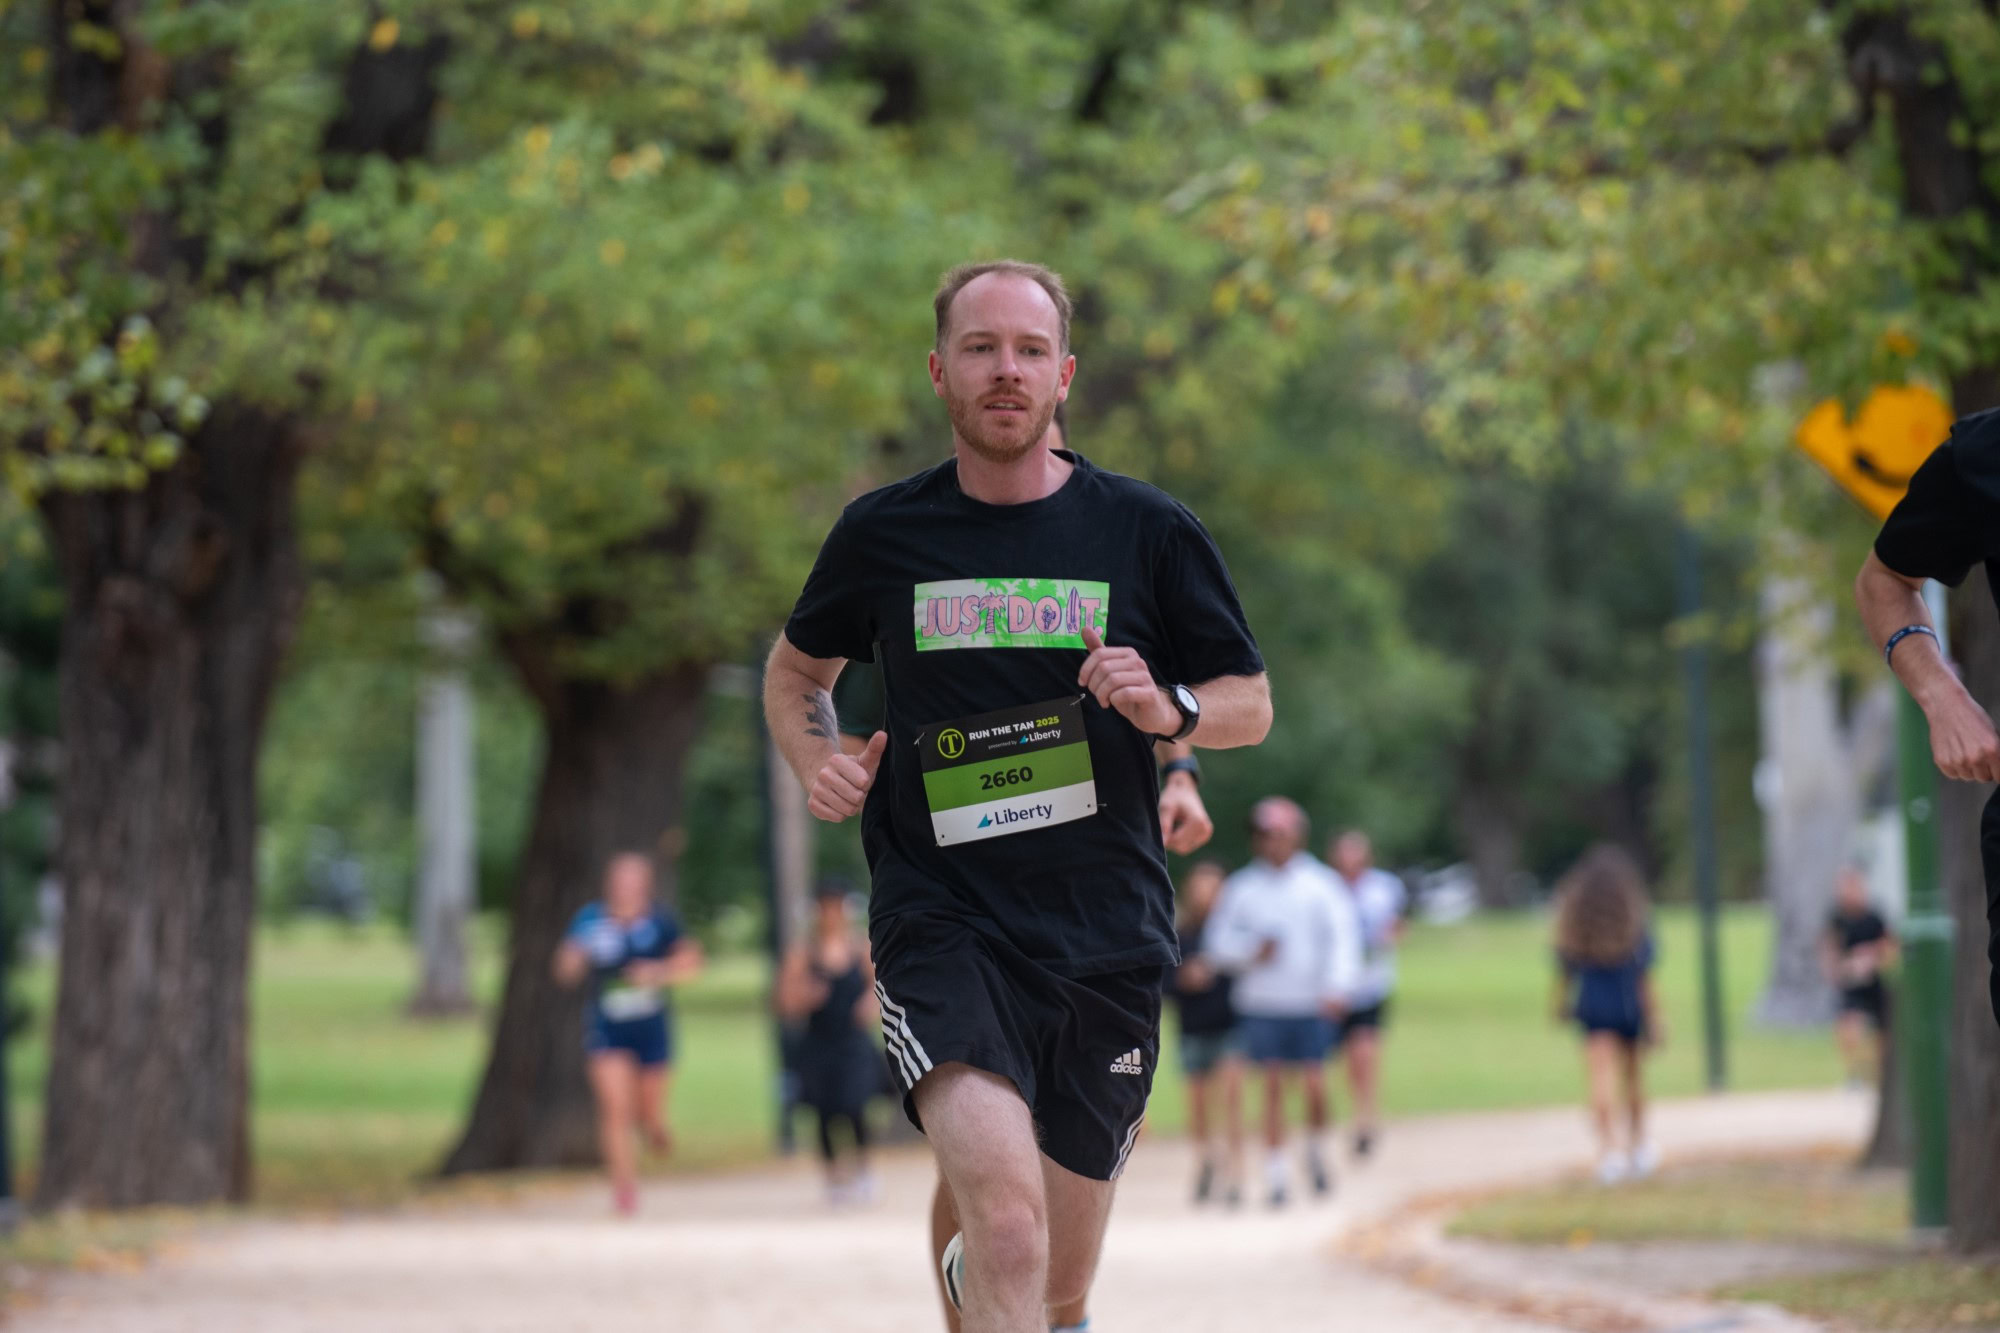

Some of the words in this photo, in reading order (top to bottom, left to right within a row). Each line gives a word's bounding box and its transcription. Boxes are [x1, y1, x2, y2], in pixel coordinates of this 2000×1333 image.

[921, 592, 1006, 637] JUST
[1008, 595, 1062, 633] DO
[969, 730, 990, 741] RUN
[991, 725, 1012, 736] THE
[1013, 720, 1035, 732] TAN
[1036, 715, 1060, 727] 2025
[988, 740, 1011, 750] presented
[1011, 739, 1017, 747] by
[1029, 728, 1061, 742] Liberty
[943, 733, 959, 755] T
[979, 766, 1033, 790] 2660
[995, 803, 1053, 825] Liberty
[1110, 1061, 1143, 1075] adidas
